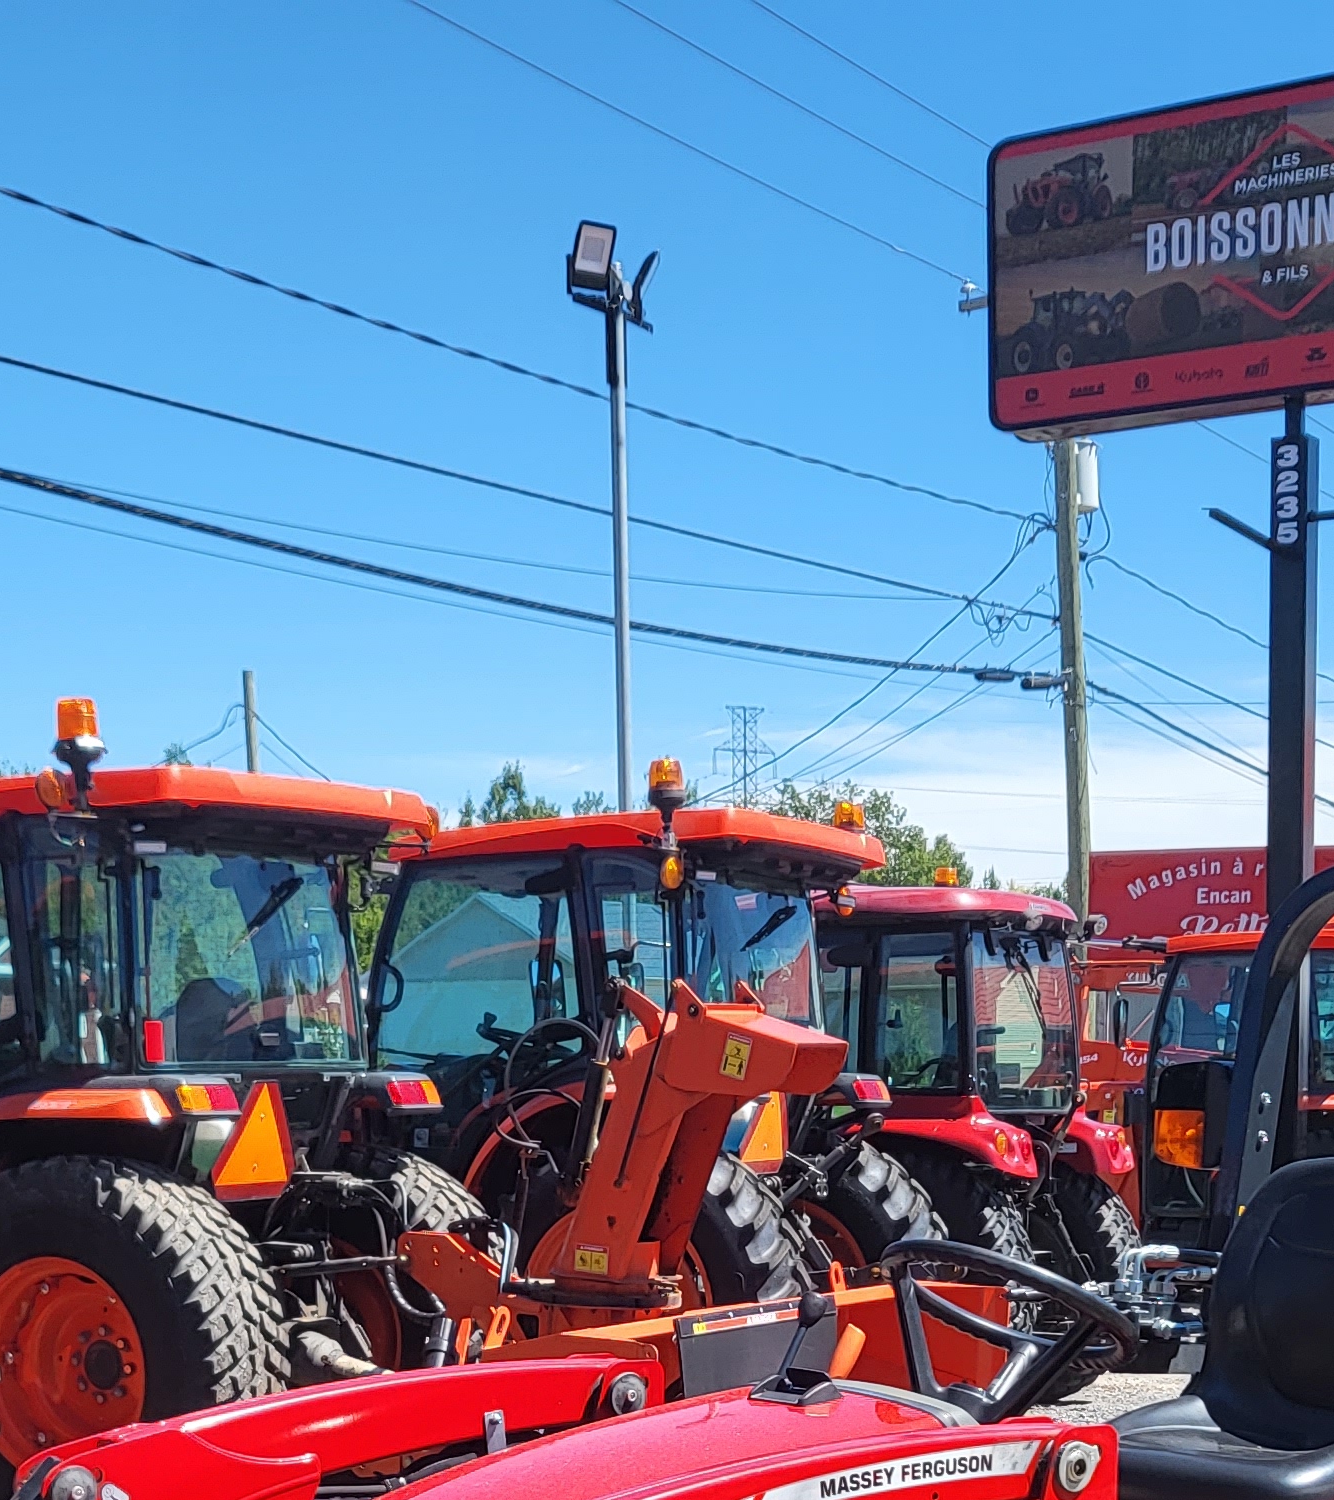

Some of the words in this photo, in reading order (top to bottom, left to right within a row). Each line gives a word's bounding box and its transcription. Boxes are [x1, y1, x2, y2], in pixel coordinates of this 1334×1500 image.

[1272, 151, 1302, 170] LES
[1260, 270, 1273, 285] &
[1275, 264, 1310, 282] FILS
[1275, 444, 1300, 546] 3235
[1126, 857, 1222, 901] Magasin
[1232, 857, 1244, 876] à
[1196, 886, 1252, 905] Encan
[819, 1466, 896, 1499] MASSEY
[900, 1453, 994, 1483] FERGUSON
